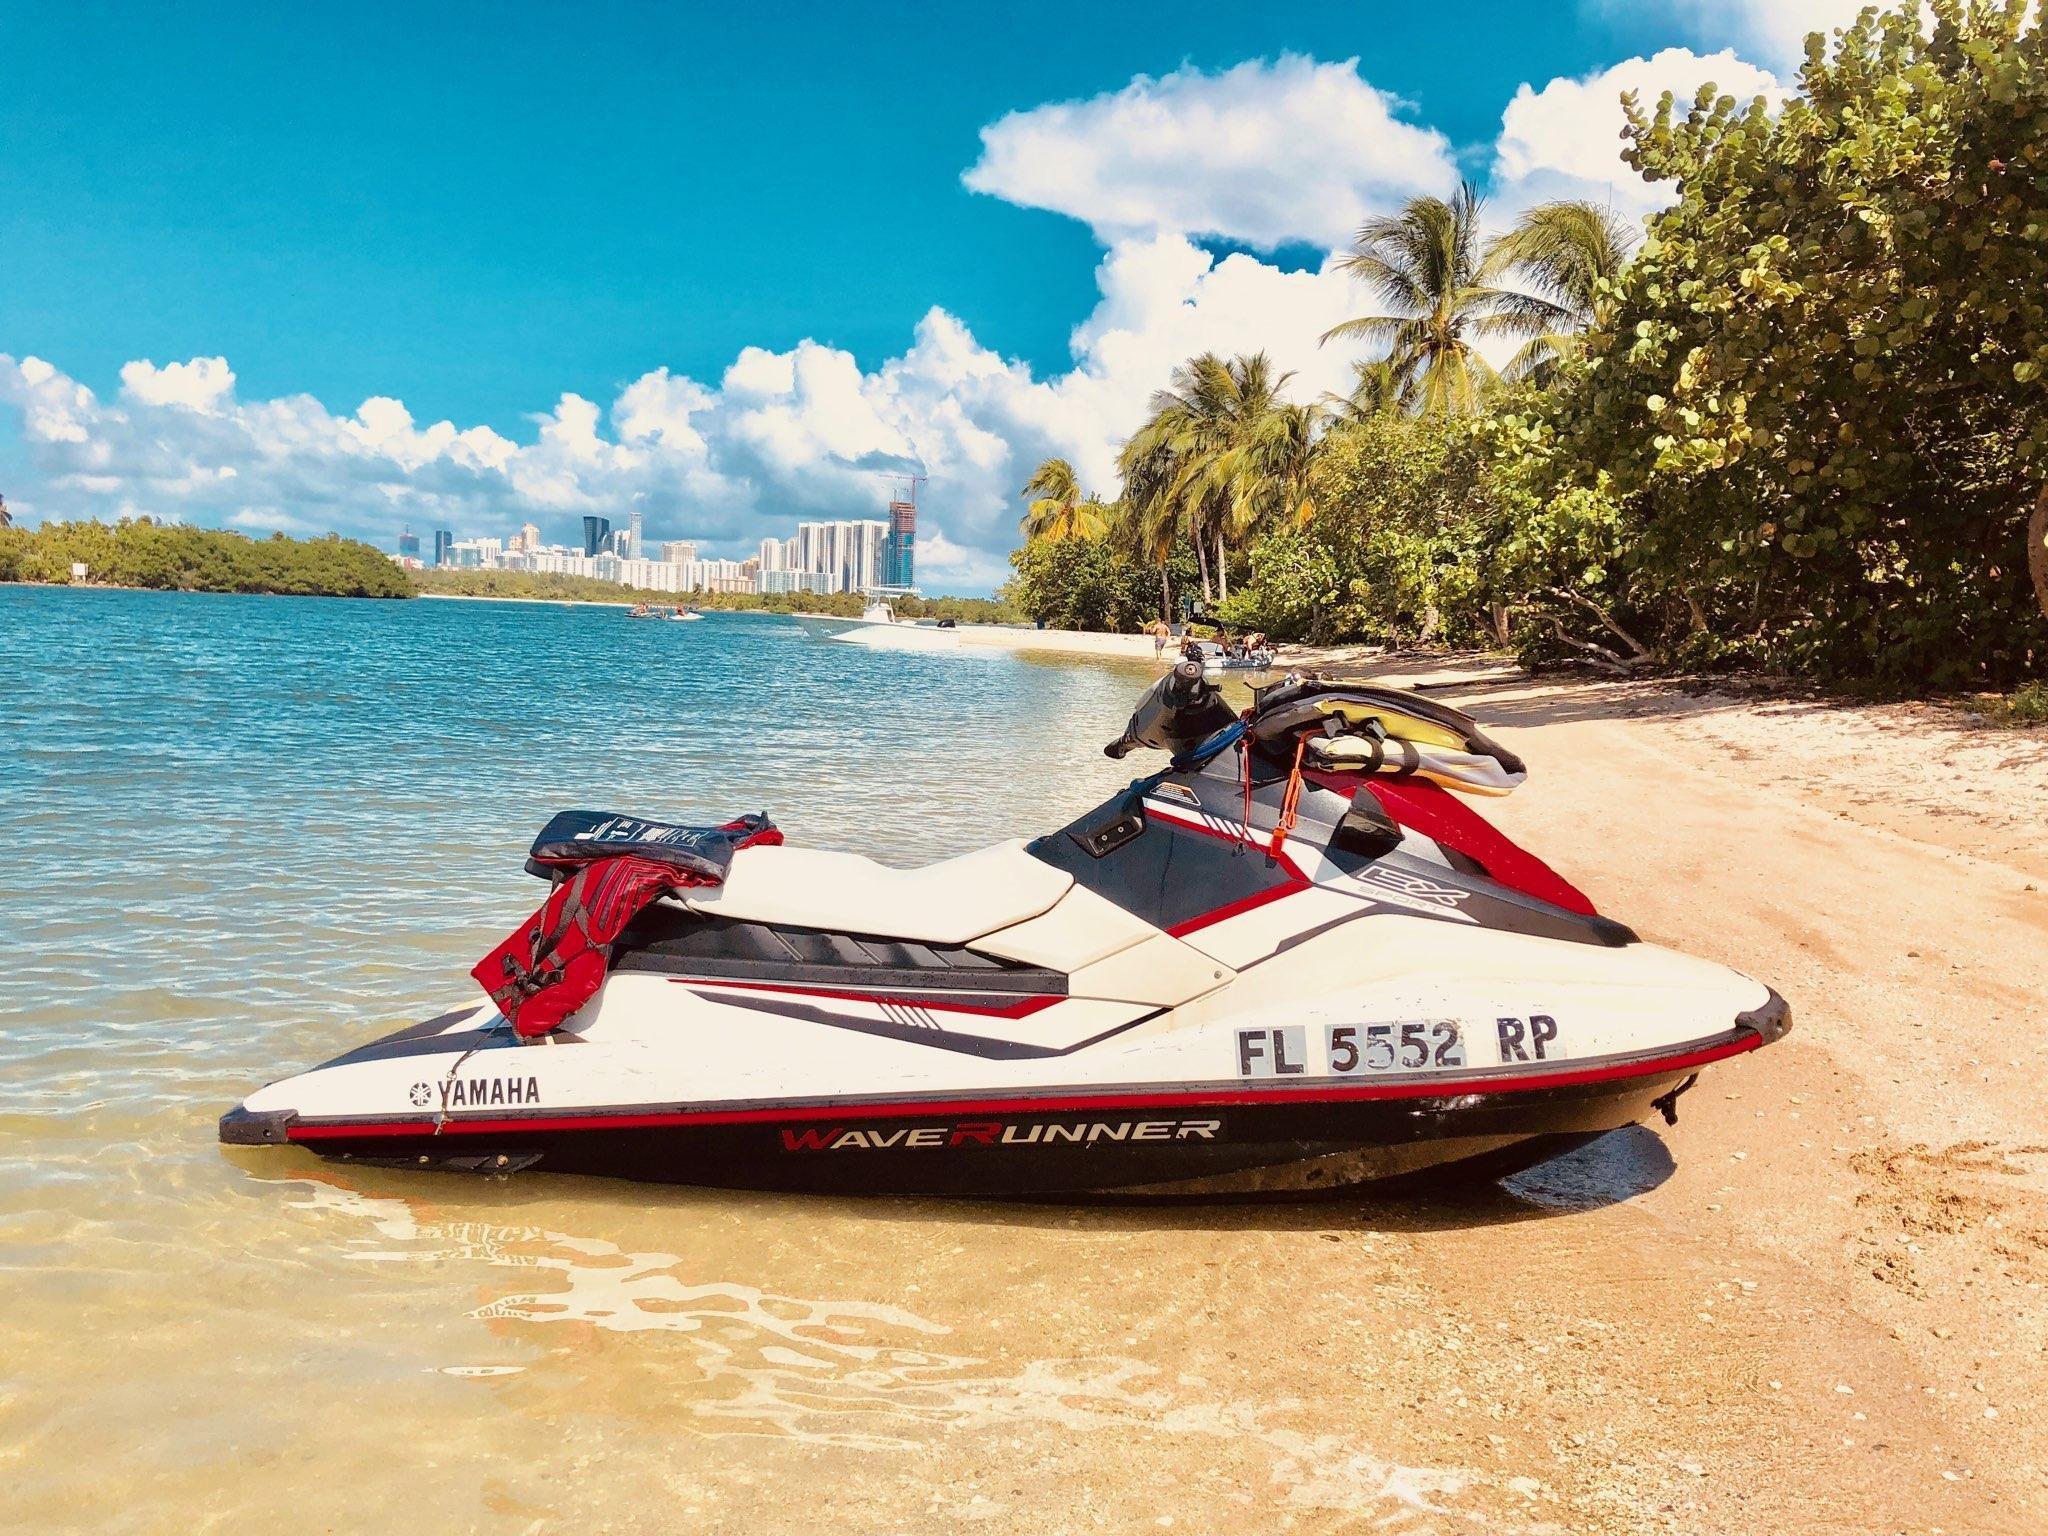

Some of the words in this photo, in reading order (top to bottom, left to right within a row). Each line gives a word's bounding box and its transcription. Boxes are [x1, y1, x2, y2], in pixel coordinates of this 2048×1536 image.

[1356, 864, 1471, 907] EX
[1238, 1028, 1305, 1076] FL
[1331, 1021, 1462, 1072] 5552
[1496, 1014, 1558, 1063] RP
[437, 1076, 540, 1106] YAMAHA
